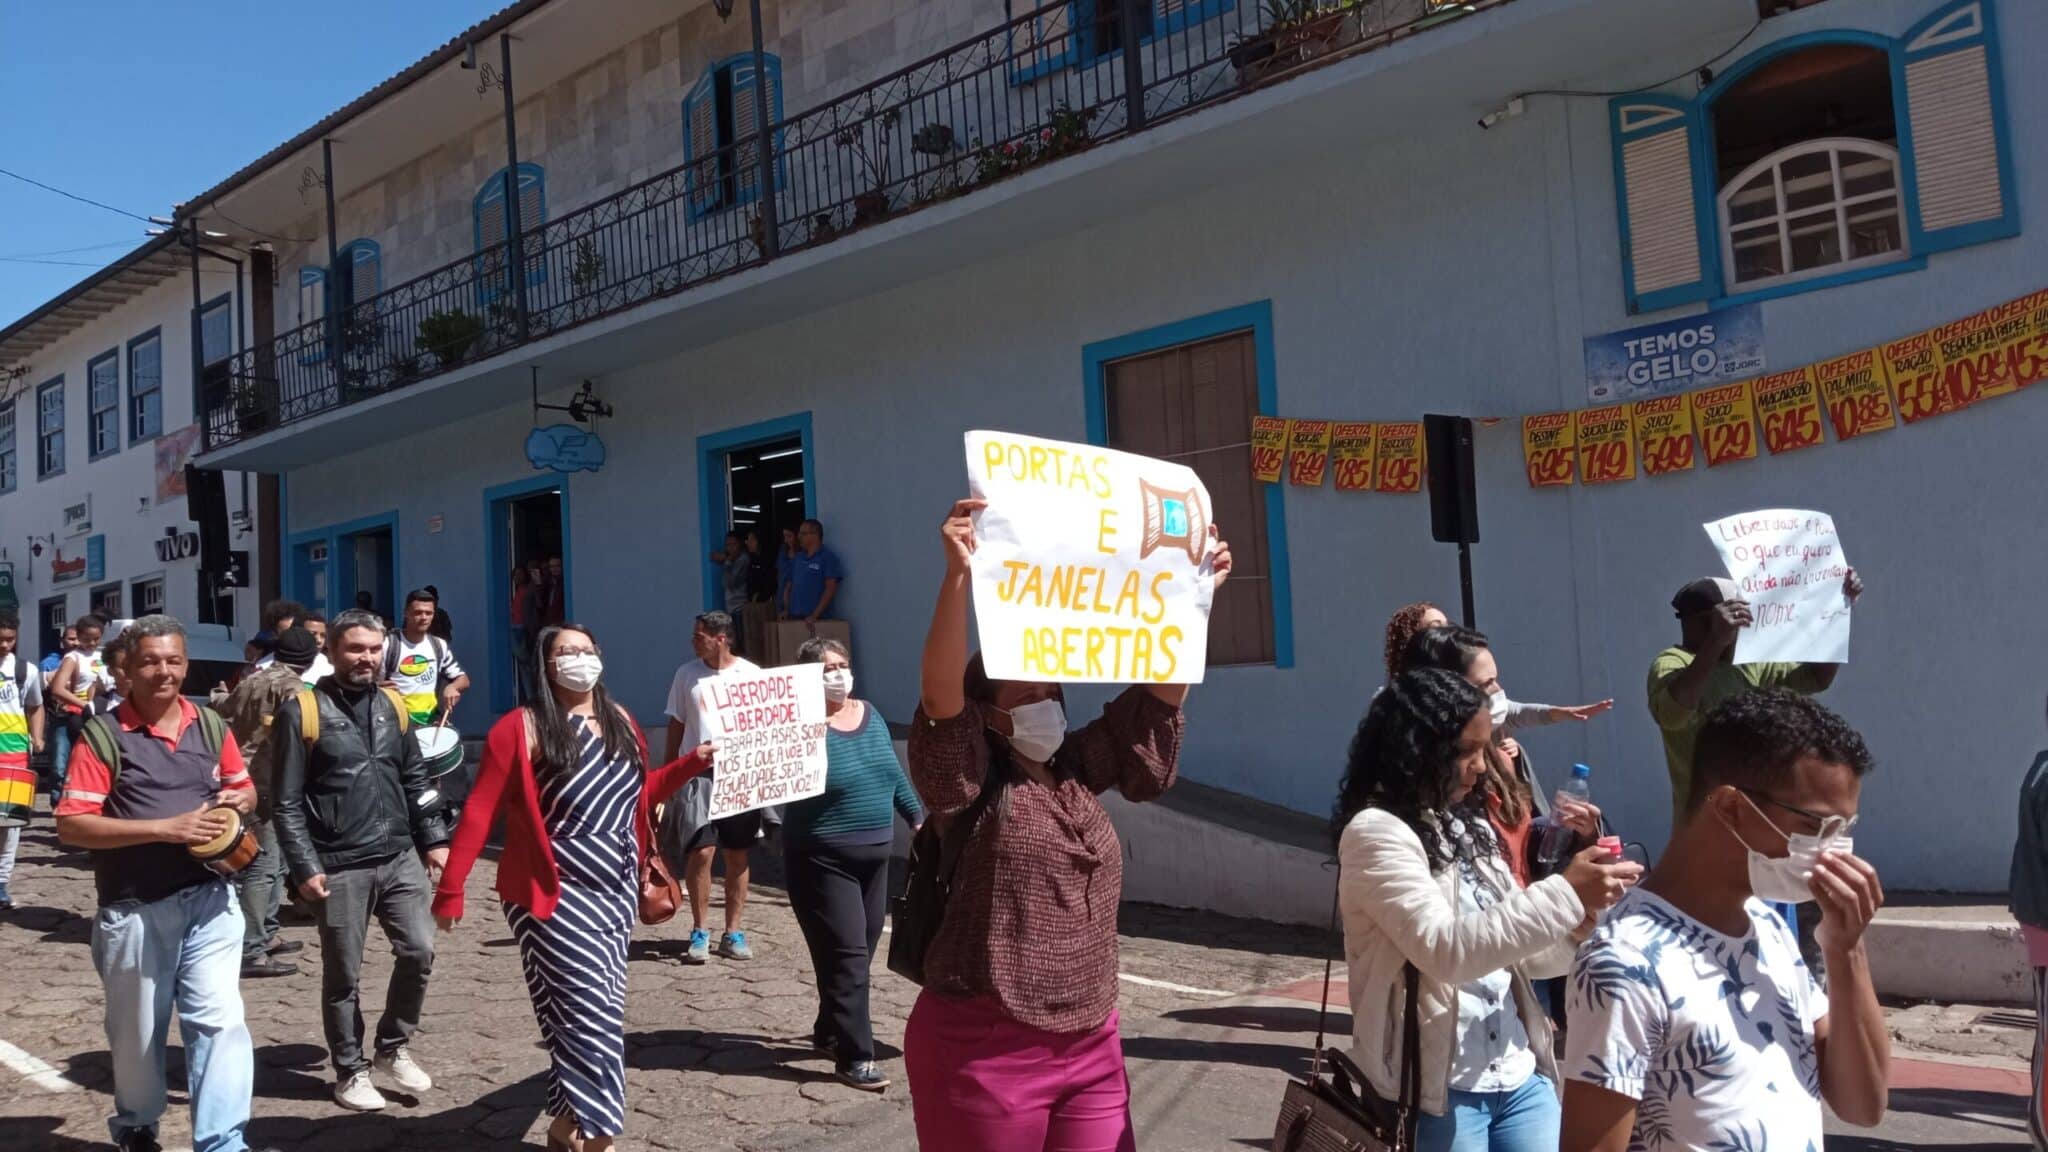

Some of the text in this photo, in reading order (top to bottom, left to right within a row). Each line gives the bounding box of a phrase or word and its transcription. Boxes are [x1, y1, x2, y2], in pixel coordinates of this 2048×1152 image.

[1933, 314, 1990, 342] OFERTA
[1624, 325, 1716, 359] TEMOS
[1887, 333, 1931, 361] OFERT
[1627, 347, 1718, 386] GELO
[1819, 351, 1873, 378] OFERTA
[1755, 369, 1805, 392] OFERTA
[1824, 369, 1872, 394] PALMITO
[1635, 396, 1681, 415] OFERTA
[1694, 385, 1743, 407] OFERTA
[1526, 413, 1569, 429] OFERTA
[1579, 405, 1622, 424] OFERTA
[1643, 414, 1674, 430] SUCO
[1704, 404, 1732, 419] SUCO
[1292, 420, 1328, 433] OFERTA
[1335, 423, 1371, 437] OFERTA
[1380, 424, 1418, 436] OFERTA
[983, 441, 1113, 499] PORTAS
[1097, 508, 1120, 554] E
[1734, 545, 1749, 561] O
[1753, 544, 1781, 571] que
[1785, 544, 1800, 557] eu
[996, 560, 1173, 625] JANELAS
[1781, 570, 1802, 591] não
[1023, 625, 1183, 682] ABERTAS
[756, 731, 769, 747] AS
[772, 726, 799, 745] ASAS
[755, 748, 775, 768] QUE
[775, 746, 784, 763] A
[785, 744, 803, 760] VOZ
[806, 742, 818, 758] DA
[717, 761, 804, 796] IGUALDADE SEJA
[711, 791, 753, 816] SEMPRE
[757, 784, 788, 803] NOSSA
